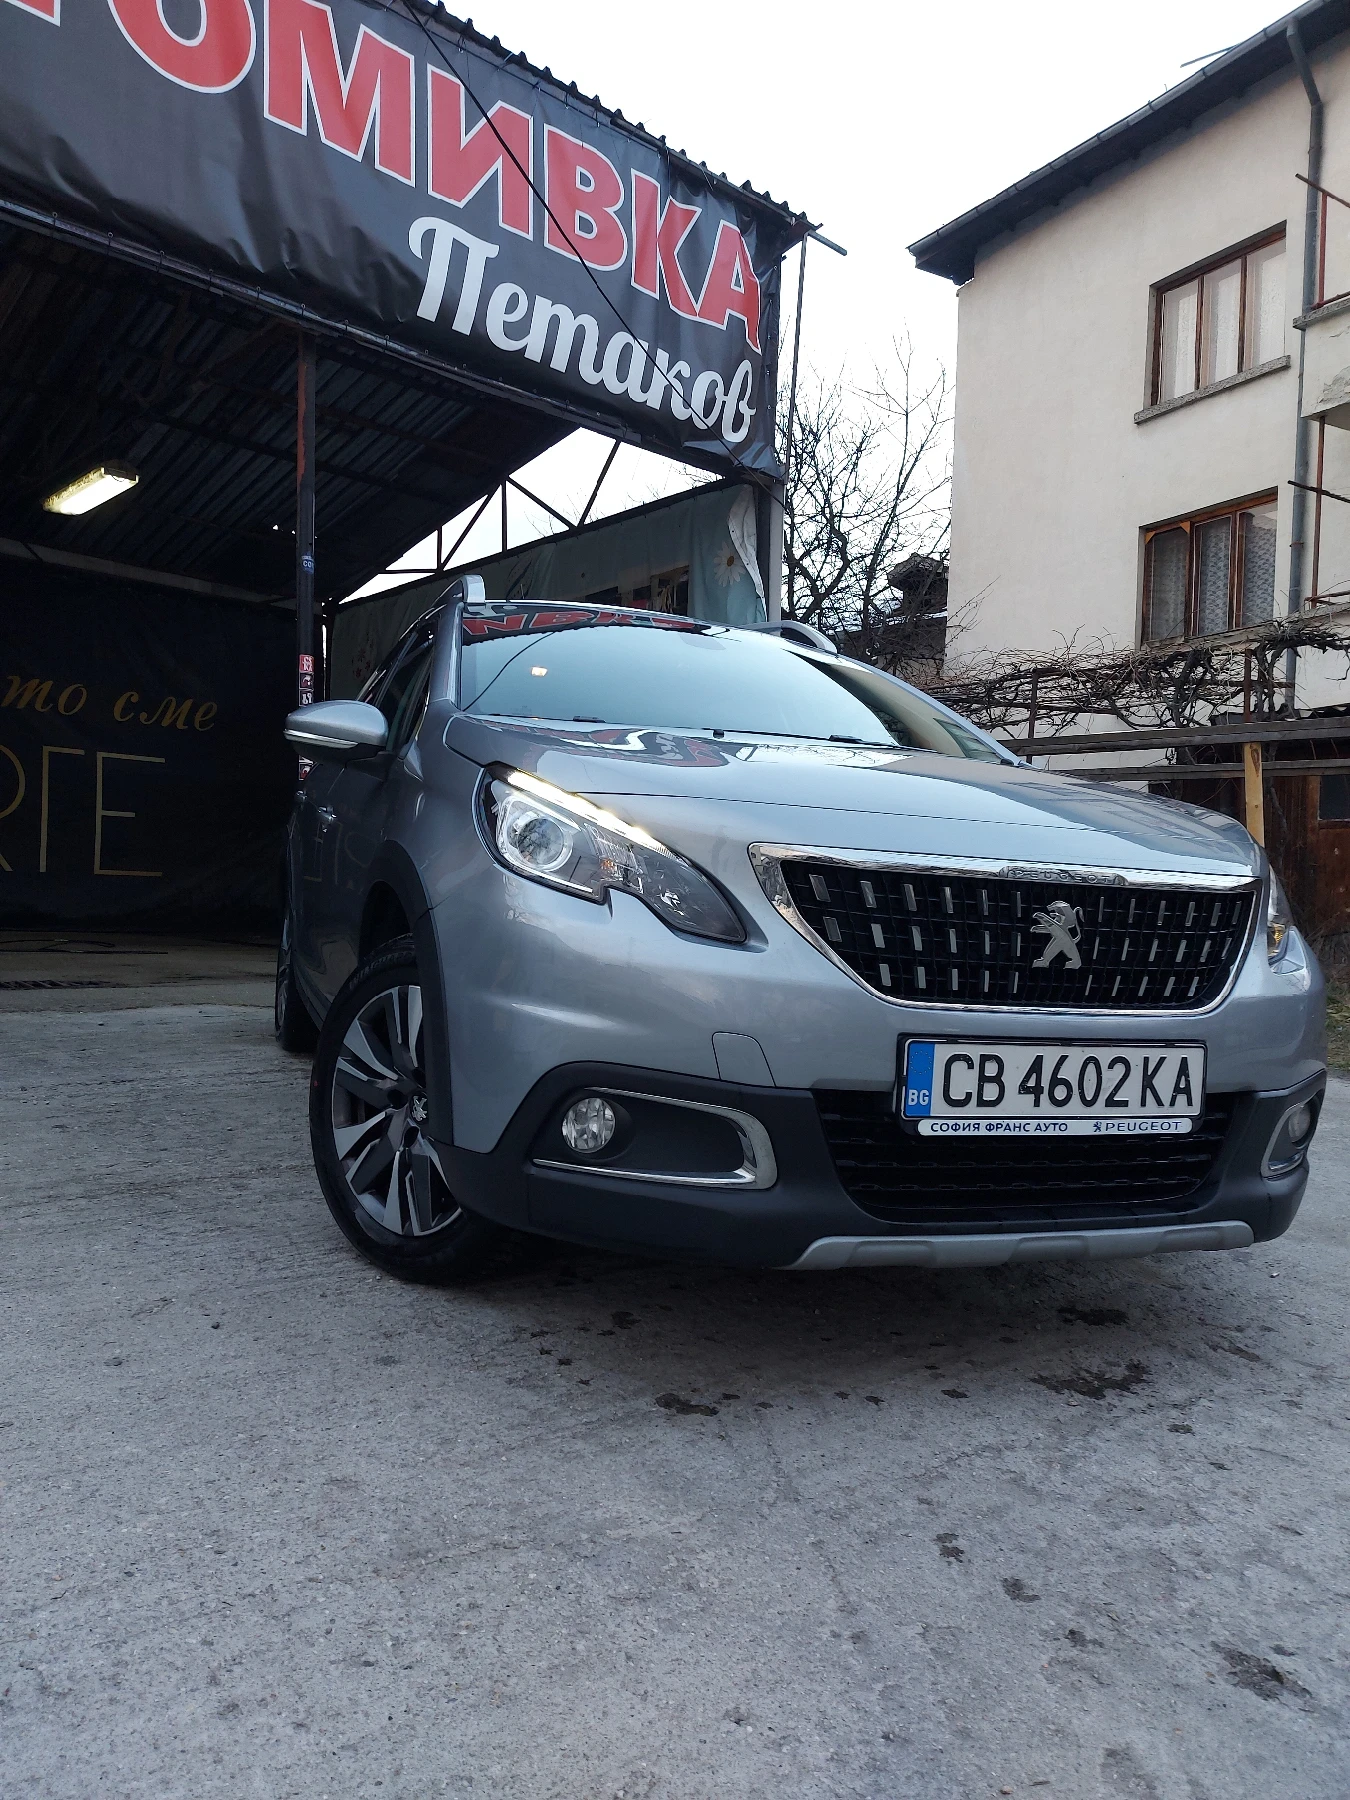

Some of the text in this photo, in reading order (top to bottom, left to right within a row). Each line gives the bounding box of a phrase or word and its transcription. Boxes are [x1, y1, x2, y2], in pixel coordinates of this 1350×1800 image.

[3, 0, 762, 355] ОМИВКА
[408, 216, 756, 443] Петаков
[113, 690, 218, 732] сме
[1014, 870, 1111, 884] PEUGEOT
[1018, 1054, 1132, 1108] 4602
[908, 1089, 930, 1106] BG
[930, 1122, 1069, 1133] СОФИЯ ФРАНС АУТО
[1105, 1121, 1182, 1132] PEUGEOT
